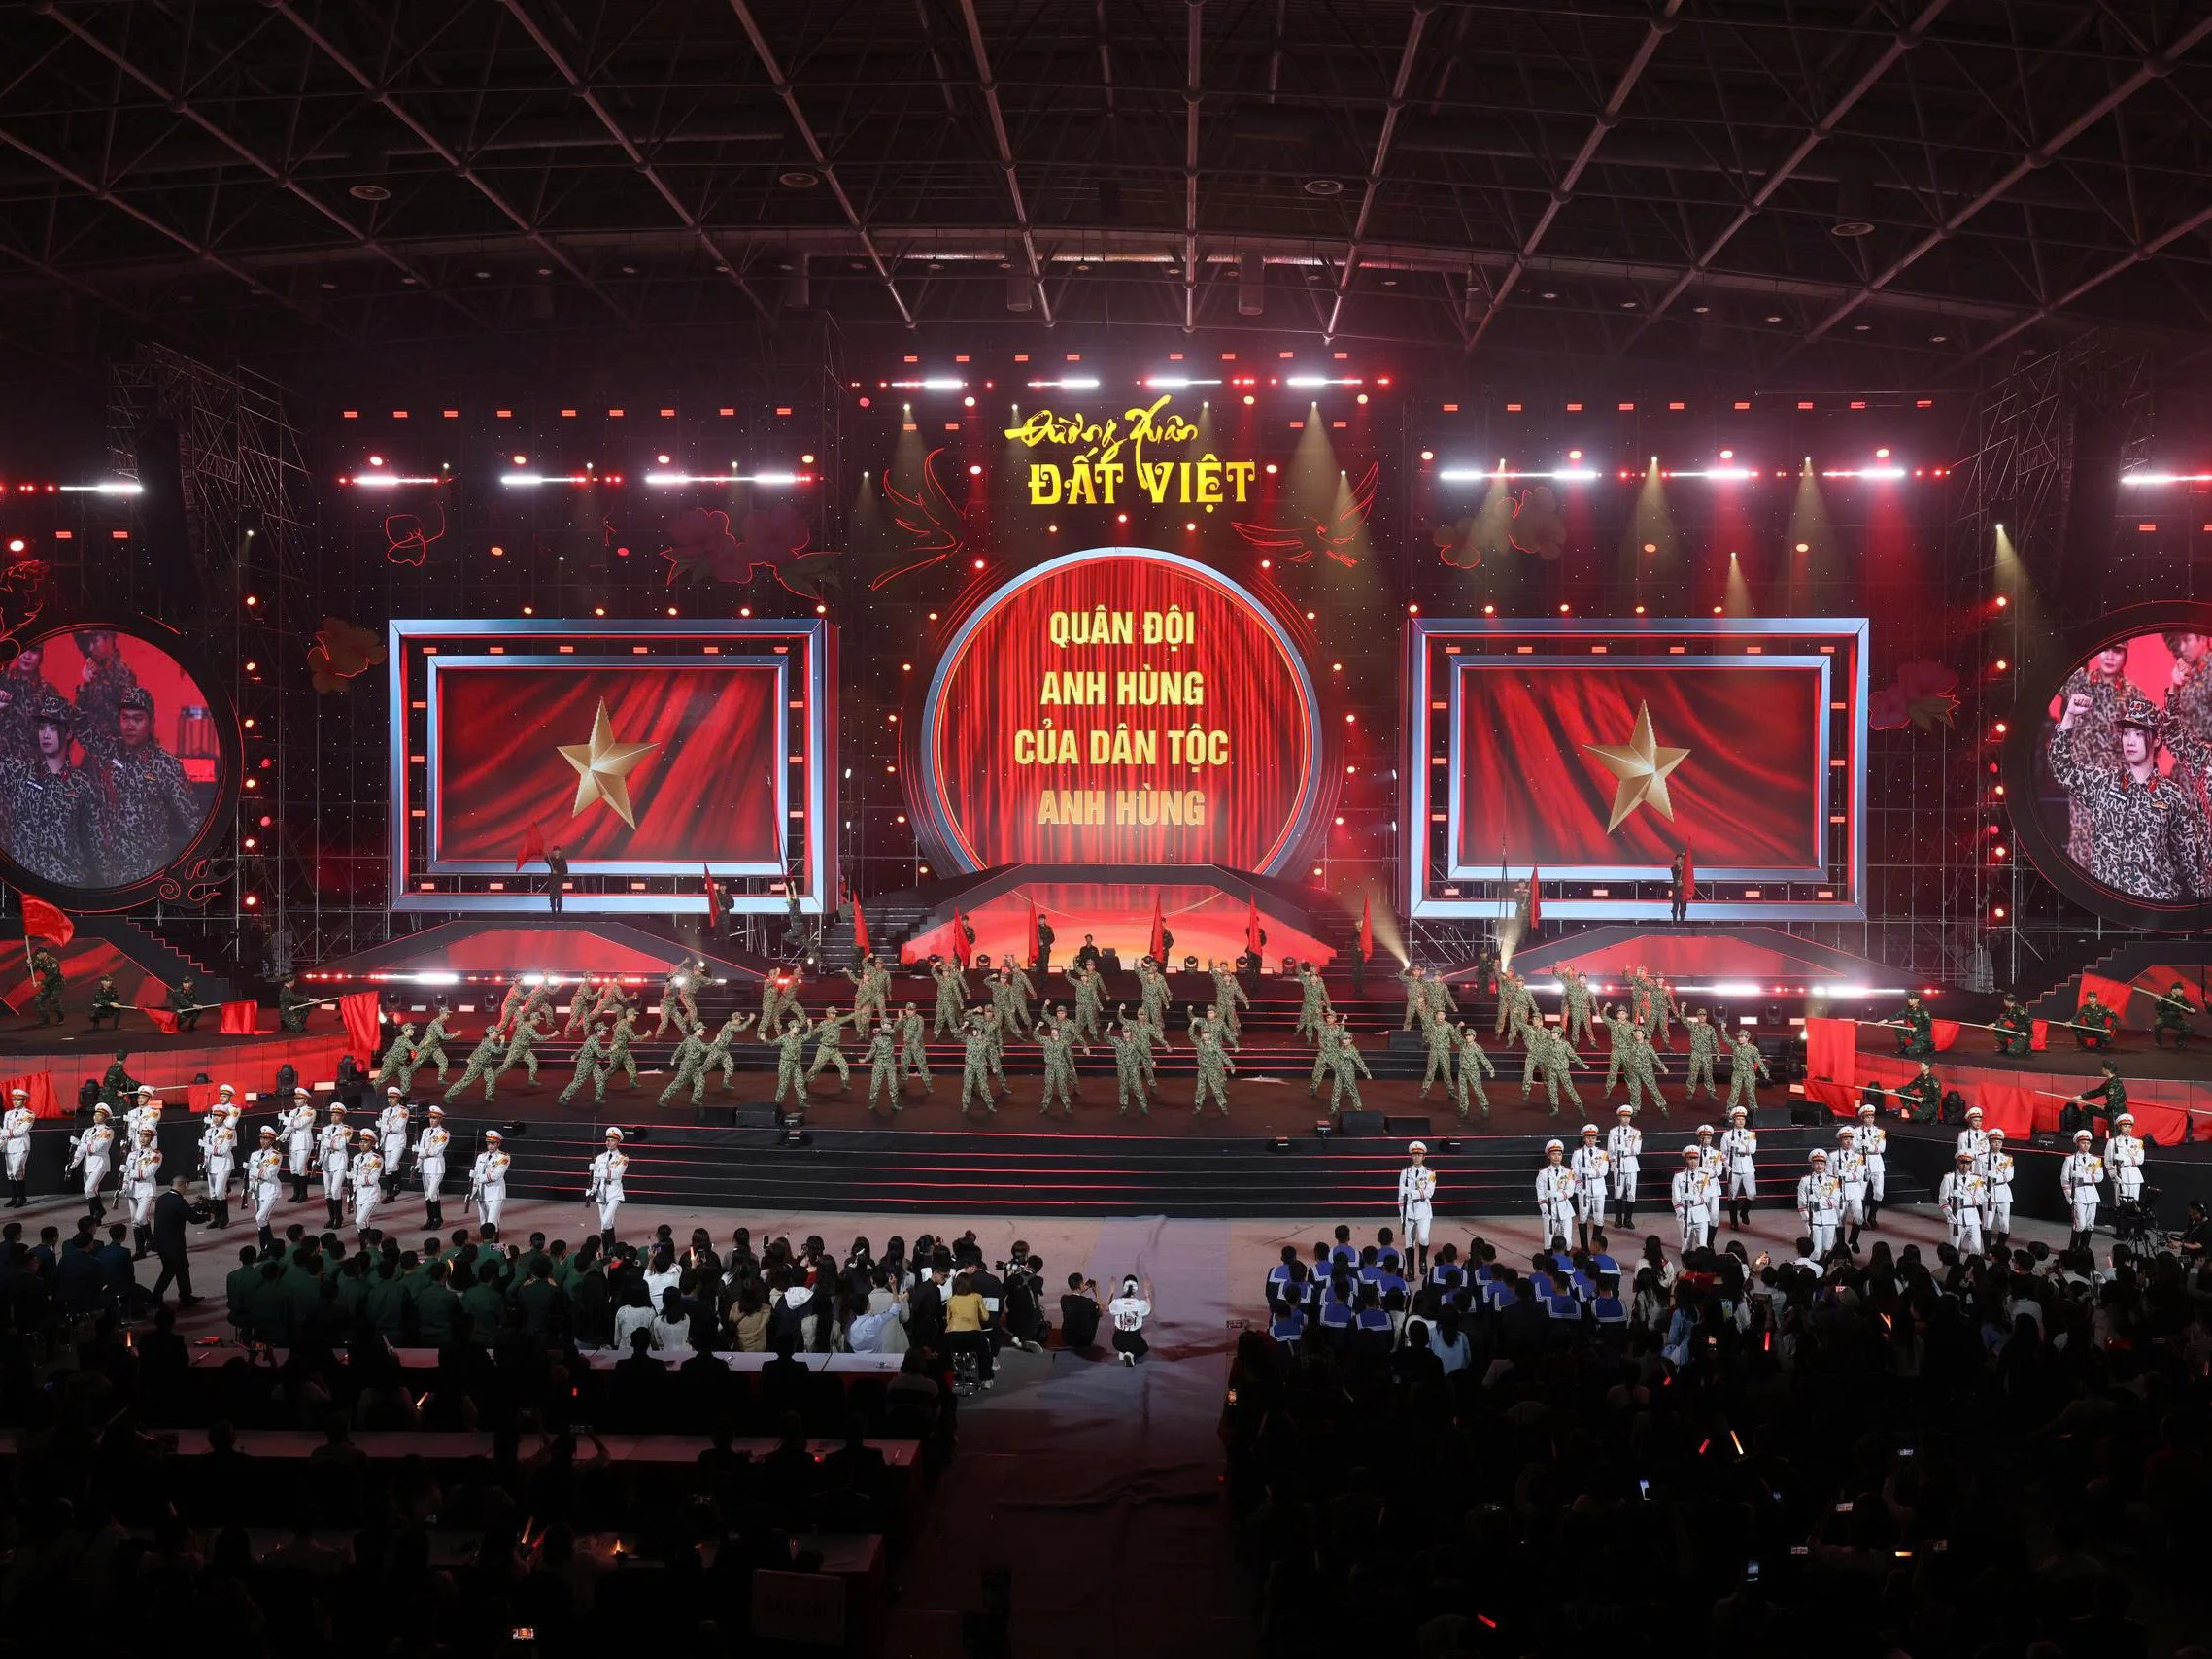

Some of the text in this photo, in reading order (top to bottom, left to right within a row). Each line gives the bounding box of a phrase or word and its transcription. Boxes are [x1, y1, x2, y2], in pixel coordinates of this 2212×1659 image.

[1028, 447, 1255, 513] ĐẤT VIỆT
[1050, 604, 1194, 651] QUÂN ĐỘI
[1040, 663, 1204, 706] ANH HÙNG
[1014, 718, 1229, 773] CỦA DÂN TỘC
[1038, 783, 1206, 826] ANH HÙNG
